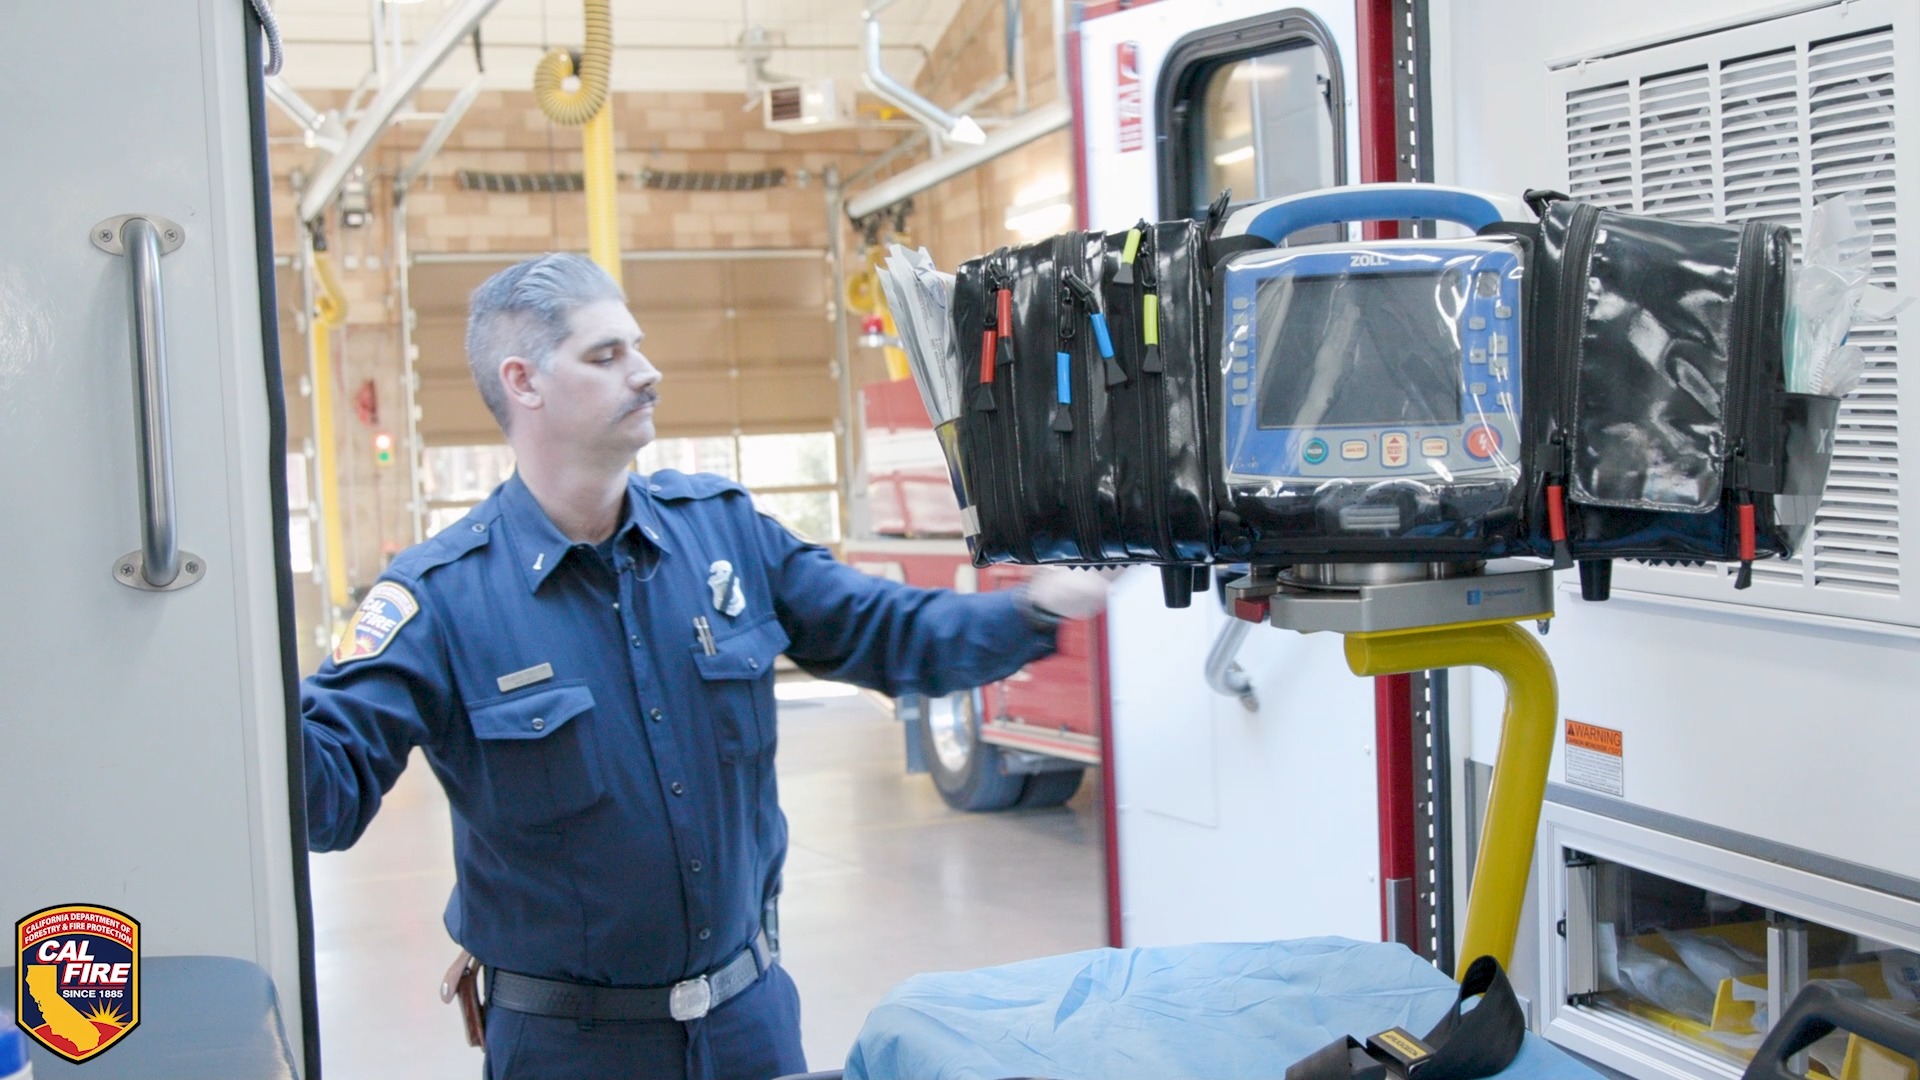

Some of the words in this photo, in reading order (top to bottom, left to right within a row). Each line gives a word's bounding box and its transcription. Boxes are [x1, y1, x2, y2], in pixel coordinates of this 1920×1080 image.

[1350, 255, 1386, 267] ZOLL
[361, 612, 398, 632] FIRE
[1575, 725, 1621, 746] WARNING
